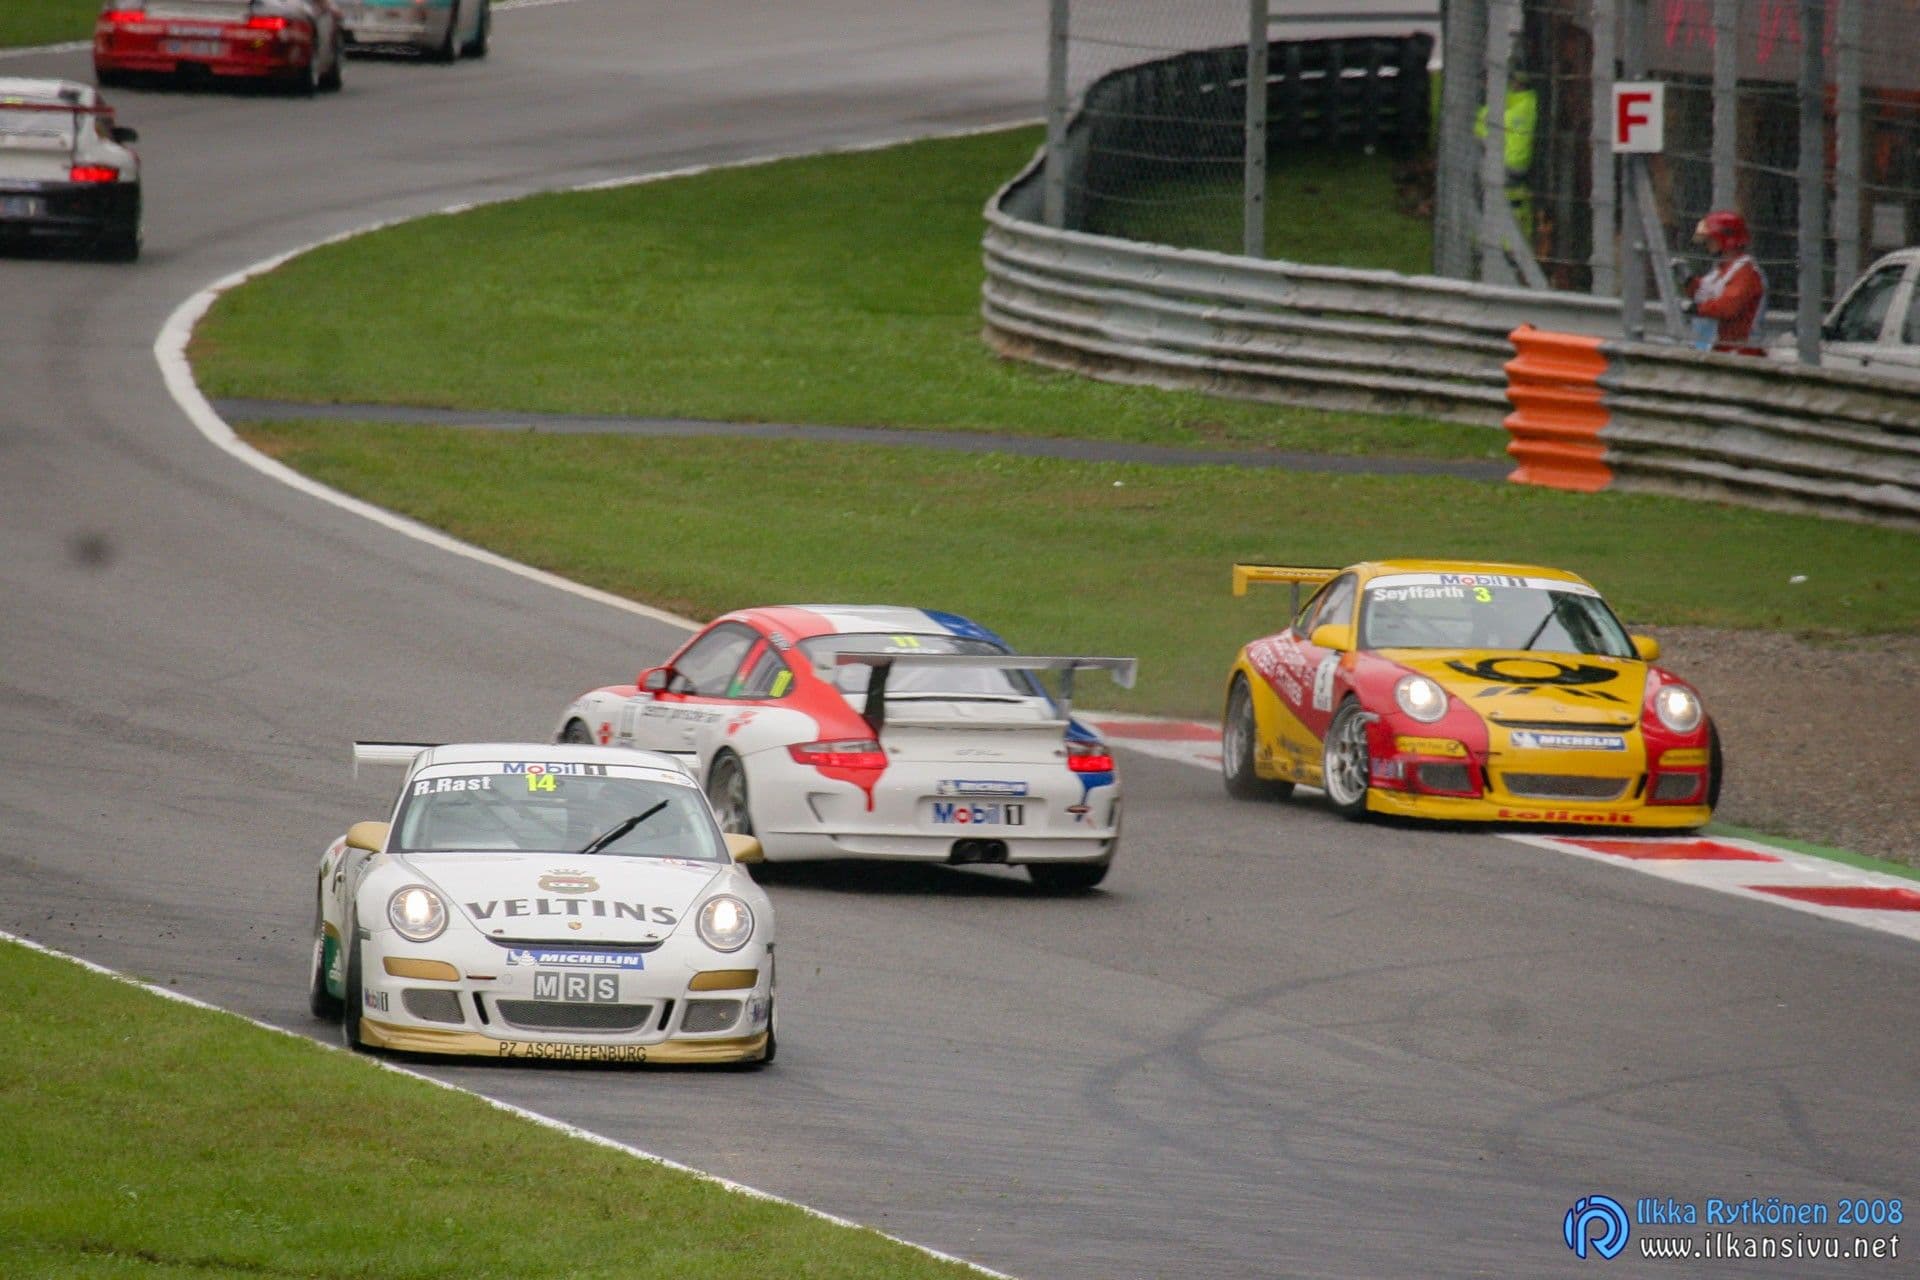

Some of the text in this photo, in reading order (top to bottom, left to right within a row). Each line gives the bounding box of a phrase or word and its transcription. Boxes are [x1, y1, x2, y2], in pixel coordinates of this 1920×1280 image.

[1617, 93, 1652, 143] F
[1440, 574, 1503, 586] Mobil
[1373, 586, 1465, 601] Seyffarth
[1473, 587, 1492, 602] 3
[1539, 734, 1622, 747] MICHELIN
[503, 763, 577, 775] Mobil
[413, 776, 491, 796] R.Rast
[525, 773, 557, 792] 14
[933, 802, 1024, 826] Mobil 1
[465, 898, 678, 926] VELTINS
[539, 952, 640, 966] MICHELIN
[500, 1042, 647, 1062] PZ ASCHAFFENBURG
